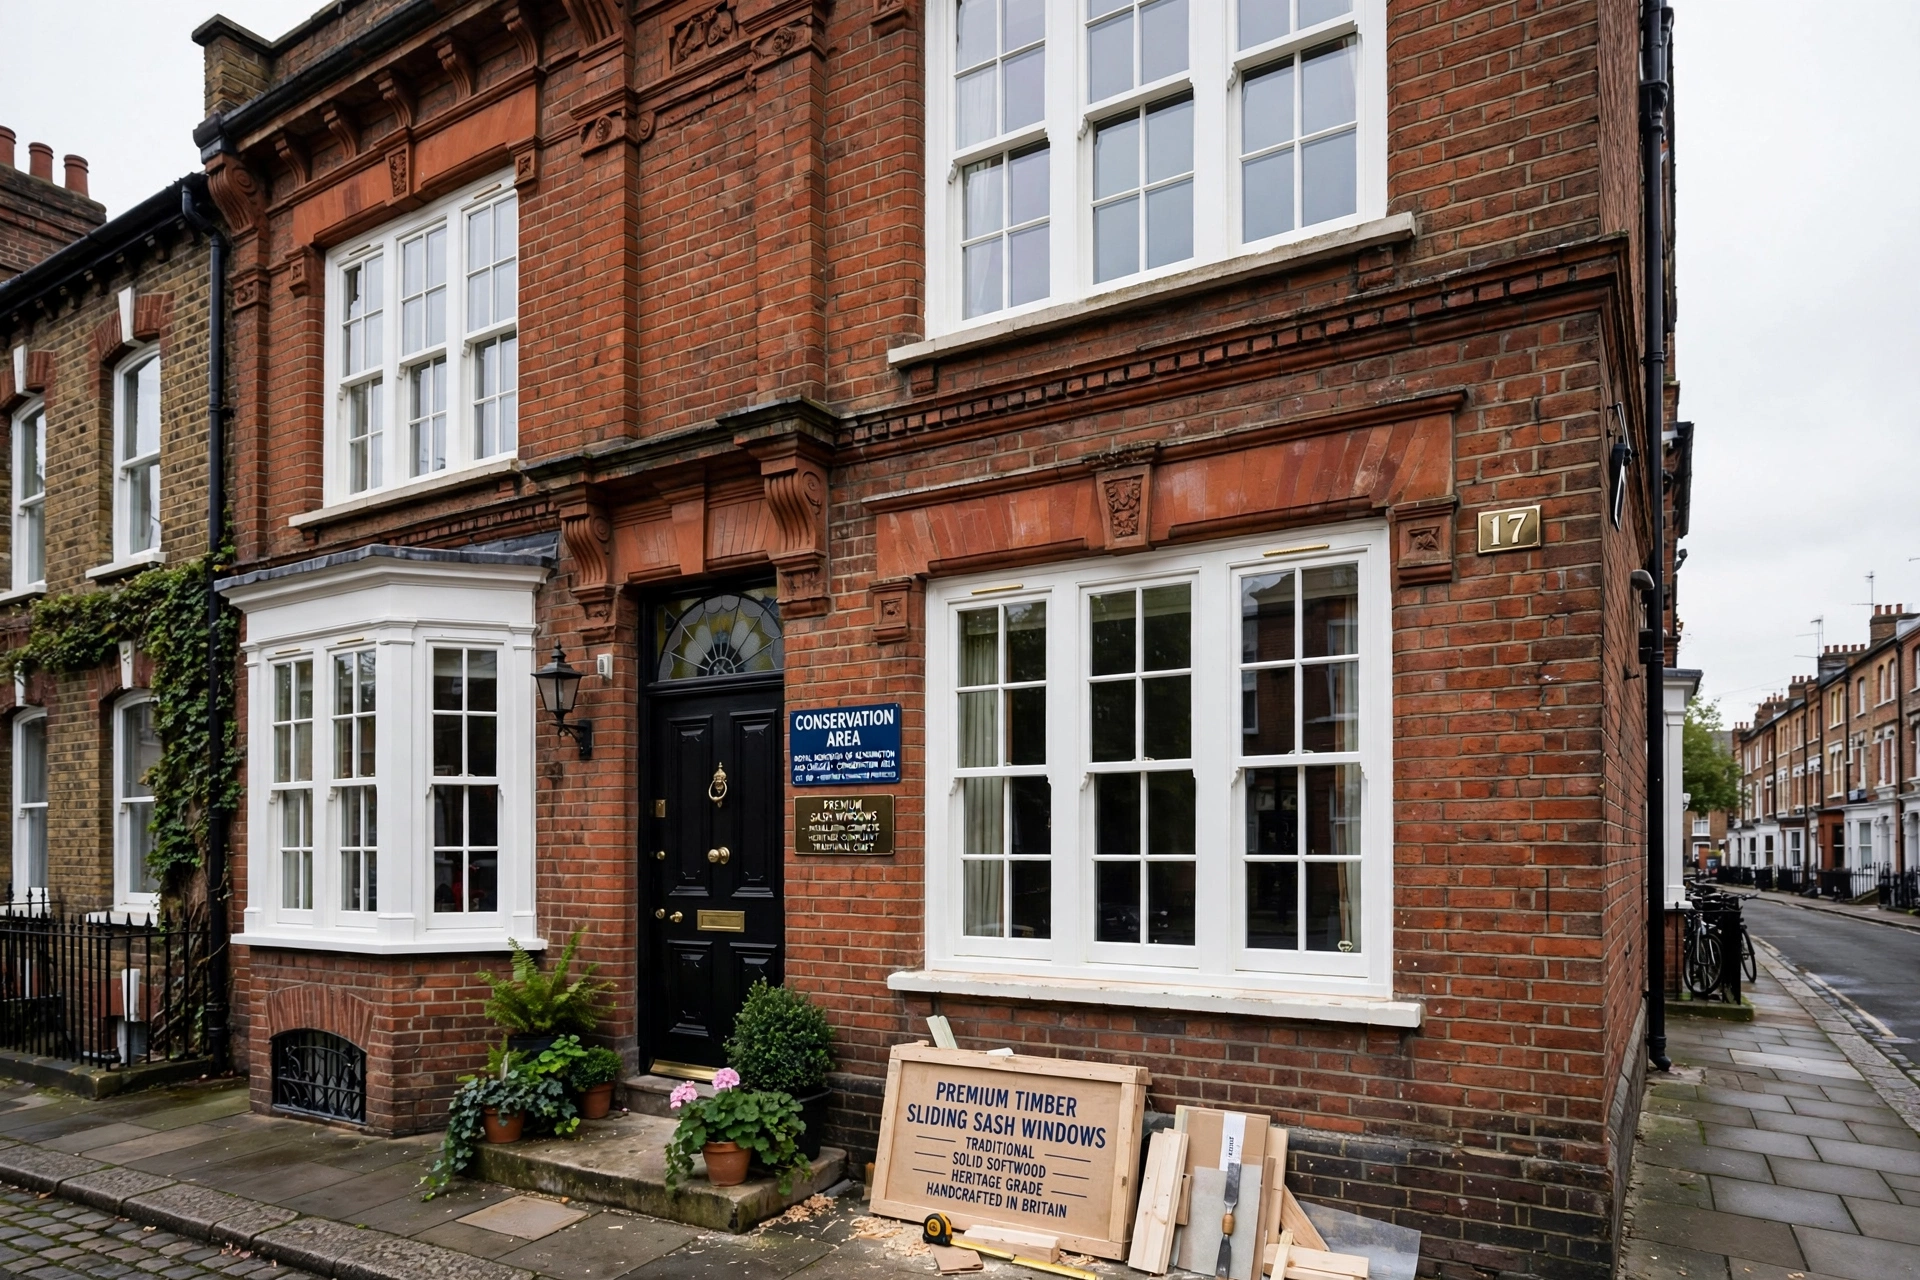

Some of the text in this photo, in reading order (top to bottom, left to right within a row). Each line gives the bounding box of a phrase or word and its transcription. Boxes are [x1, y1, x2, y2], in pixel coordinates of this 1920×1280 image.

[1490, 512, 1528, 546] 17
[795, 708, 894, 731] CONSERVATION
[826, 730, 861, 747] AREA
[935, 1081, 1077, 1118] PREMIUM TIMBER
[906, 1103, 1107, 1149] SLIDING SASH WINDOWS
[965, 1136, 1035, 1160] TRADITIONAL
[952, 1151, 1047, 1179] SOLID SOFTWOOD
[951, 1168, 1044, 1197] HERITAGE GRADE
[926, 1181, 1068, 1219] HANDCRAFTED IN BRITAIN
